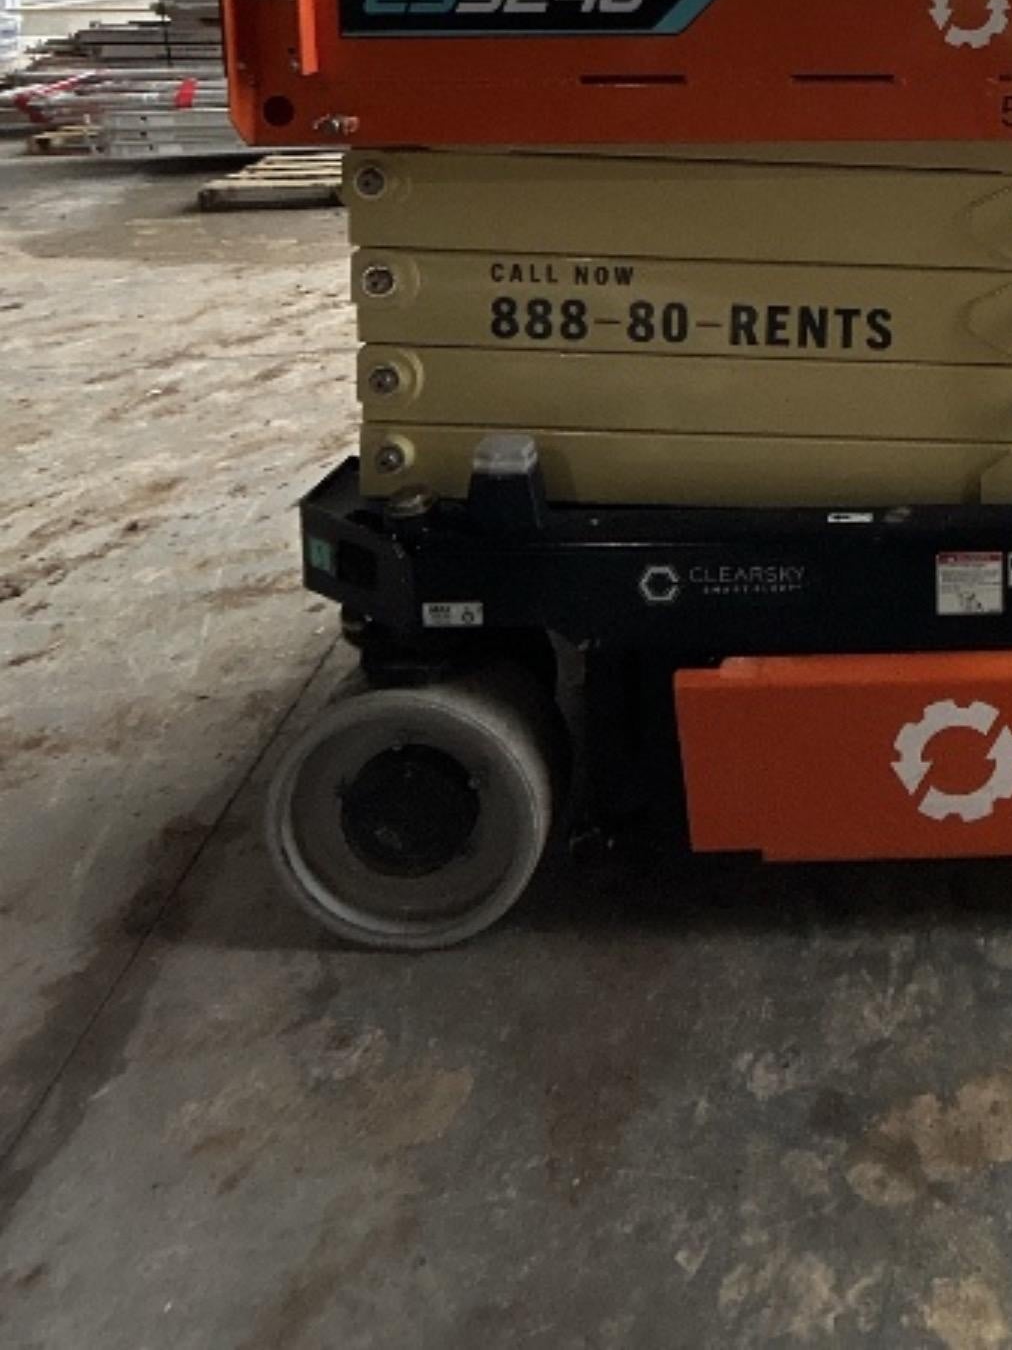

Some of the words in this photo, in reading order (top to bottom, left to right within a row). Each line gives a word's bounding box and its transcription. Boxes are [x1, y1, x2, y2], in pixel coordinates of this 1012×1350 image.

[491, 263, 559, 284] CALL
[574, 265, 635, 287] NOW
[490, 296, 893, 351] 888-80-RENTS
[688, 565, 806, 583] CLEARSKY
